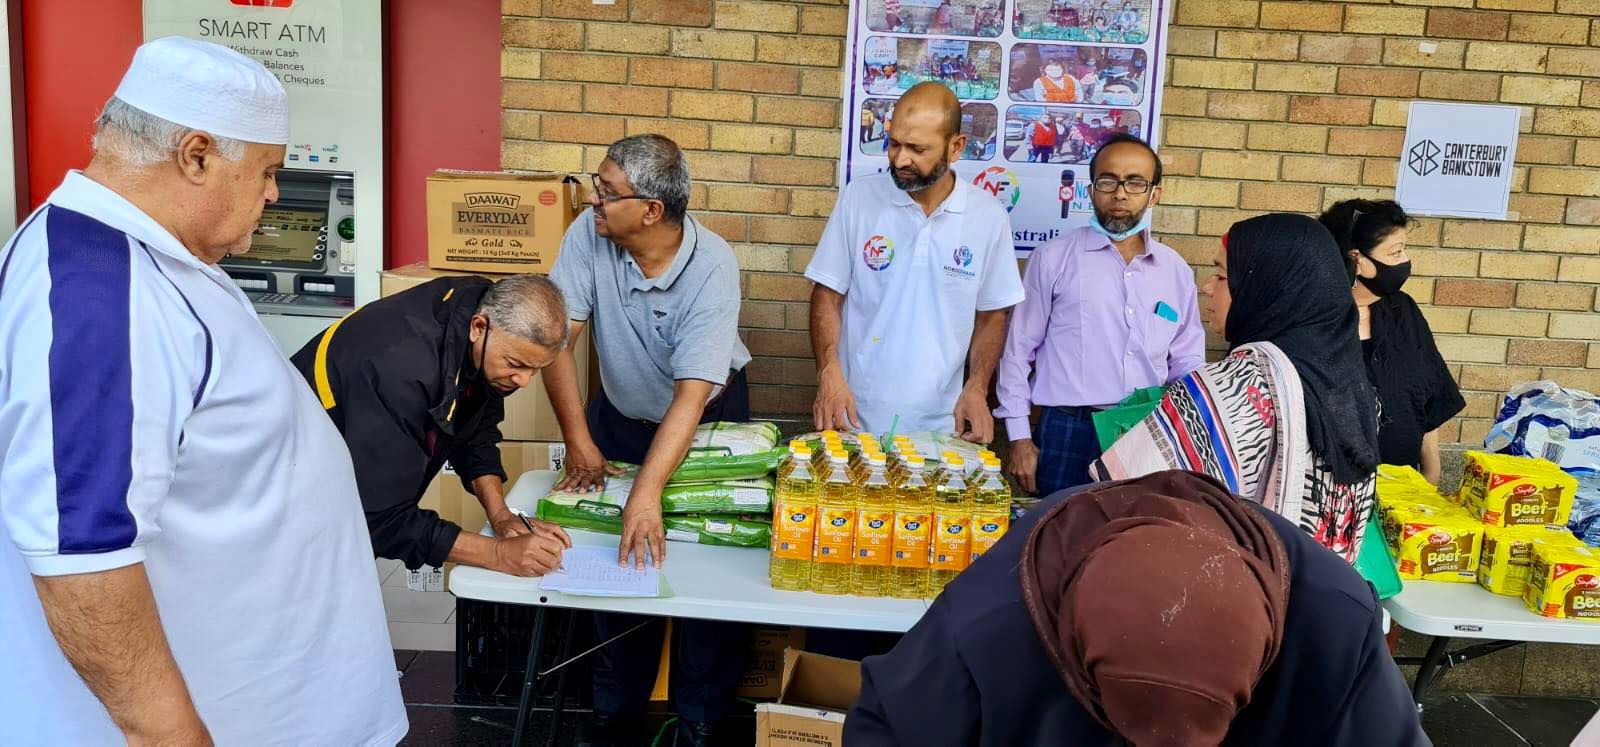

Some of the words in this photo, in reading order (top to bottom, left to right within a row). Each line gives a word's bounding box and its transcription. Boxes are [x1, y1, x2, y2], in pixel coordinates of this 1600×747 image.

[198, 18, 272, 39] SMART
[278, 23, 326, 44] ATM
[275, 48, 299, 58] Cash
[263, 60, 305, 71] Balances
[284, 74, 325, 86] Cheques
[1444, 143, 1508, 161] CANTERBURY
[1441, 160, 1502, 177] BANKSTOWN
[983, 181, 1010, 197] NF
[468, 195, 517, 207] DAAWAT
[457, 211, 530, 224] EVERYDAY
[1012, 229, 1060, 242] strali
[481, 238, 504, 248] Gold
[870, 245, 887, 258] NF
[1511, 502, 1548, 517] Beef
[1428, 549, 1462, 566] Beef
[1433, 564, 1458, 572] NOODLES
